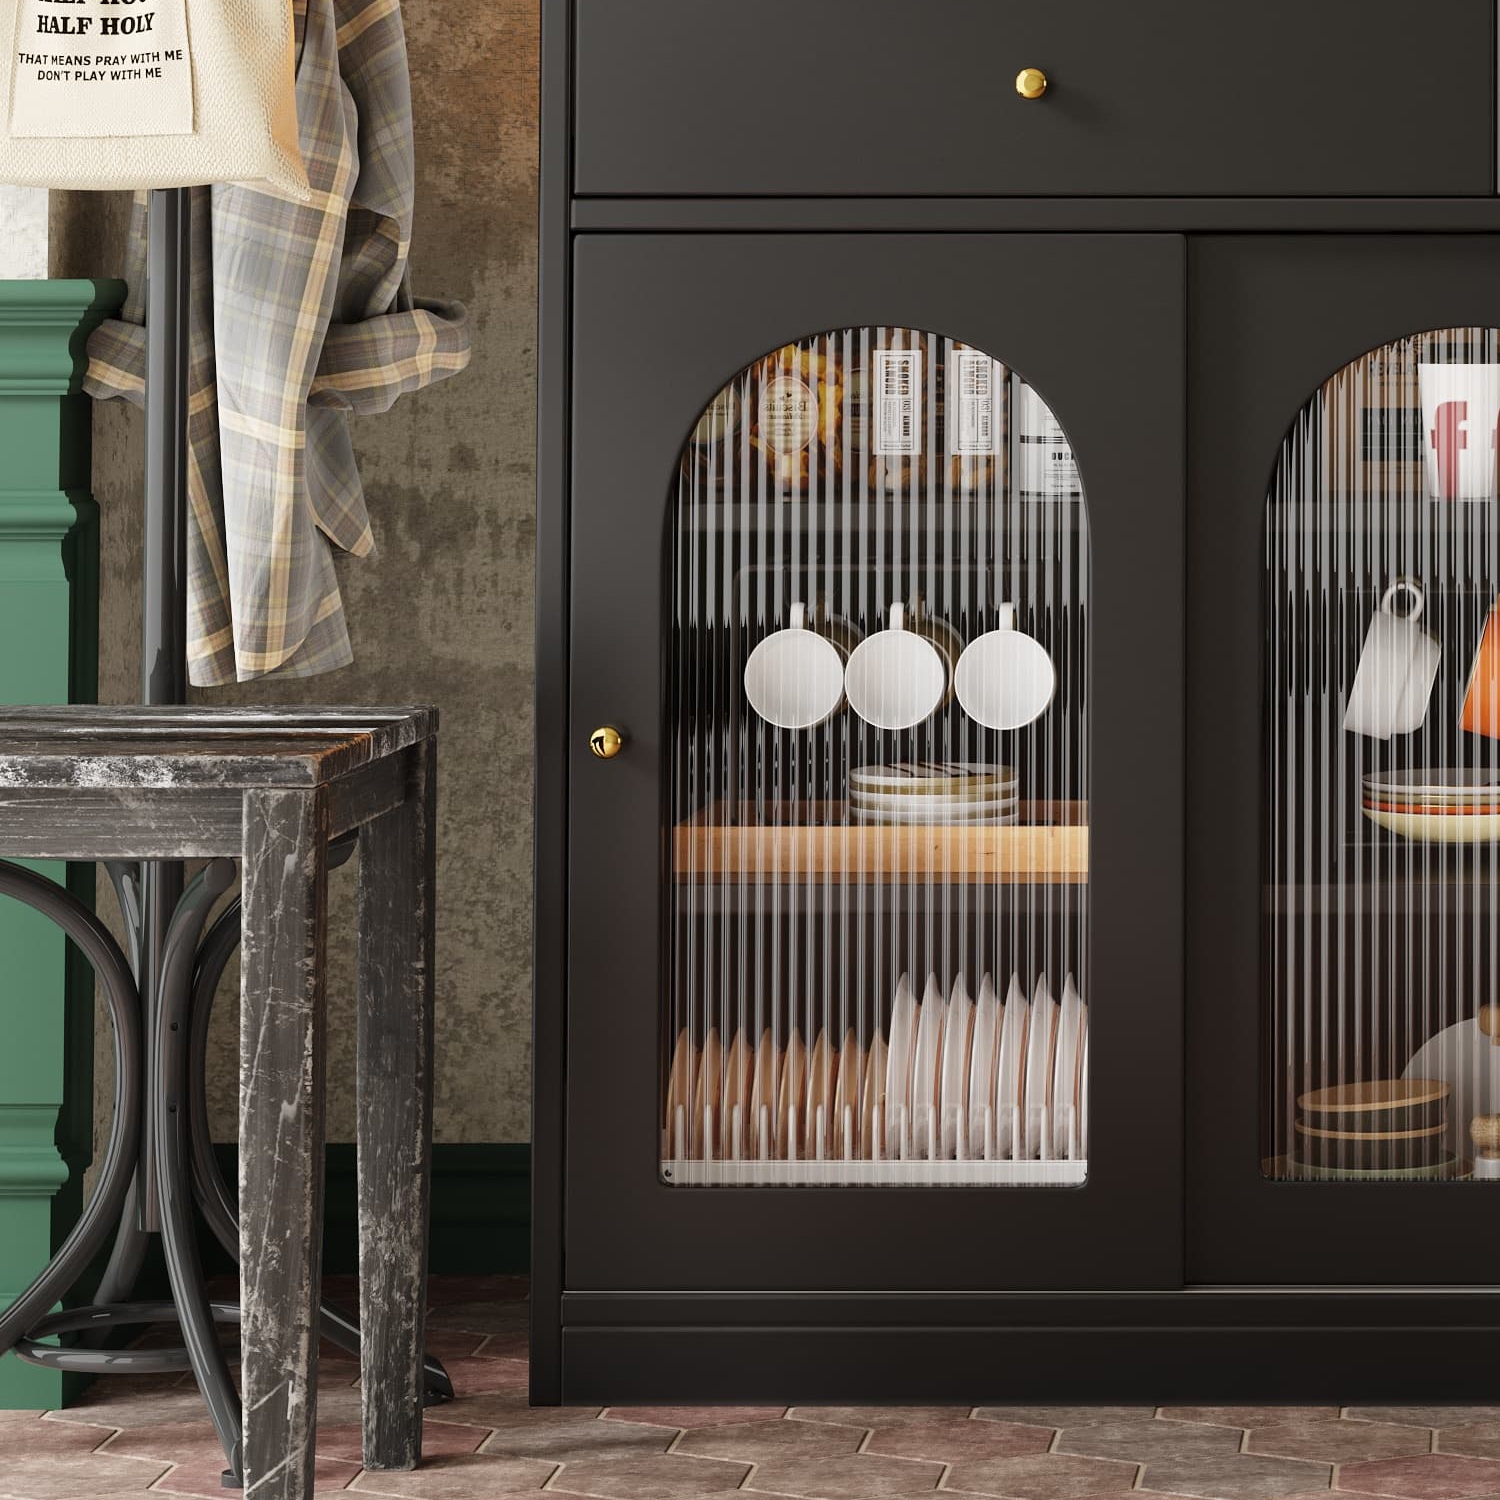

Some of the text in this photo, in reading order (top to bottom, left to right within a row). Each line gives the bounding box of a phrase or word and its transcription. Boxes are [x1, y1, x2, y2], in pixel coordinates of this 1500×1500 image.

[36, 12, 156, 36] HALF HOLY
[18, 50, 184, 66] THAT MEANS PRAY WITH ME
[37, 67, 162, 81] DON'T PLAY WITH ME
